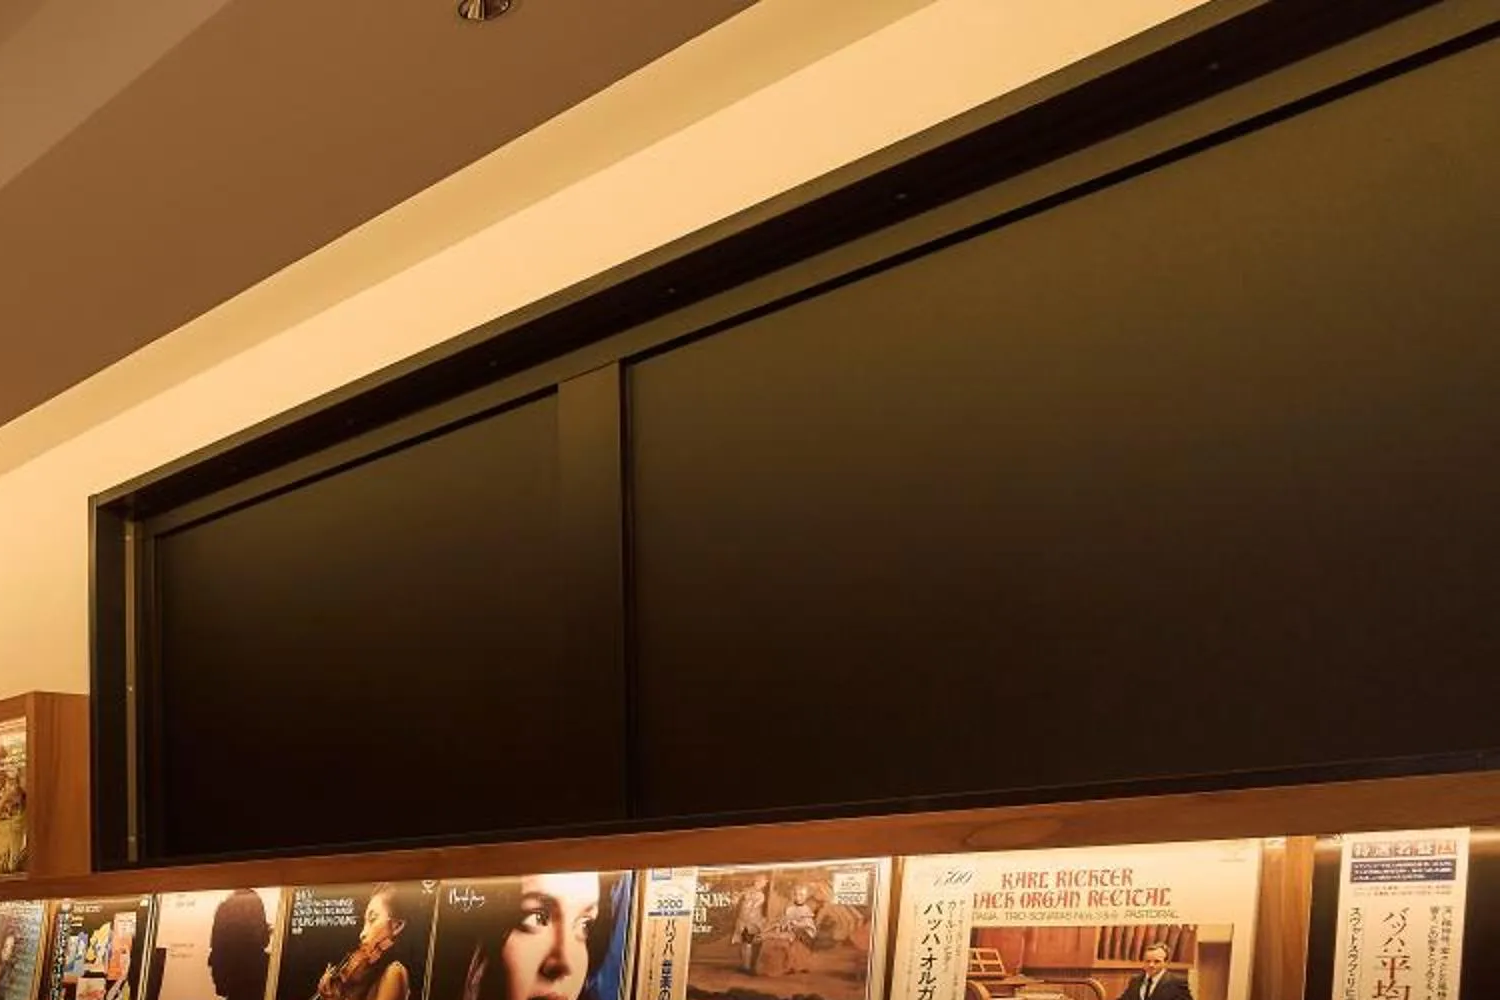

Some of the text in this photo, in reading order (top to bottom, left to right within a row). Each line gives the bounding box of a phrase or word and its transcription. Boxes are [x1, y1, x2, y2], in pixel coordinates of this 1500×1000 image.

[1001, 868, 1134, 889] KARL RICHTER
[972, 887, 1172, 909] ACH ORGAN RECITAL
